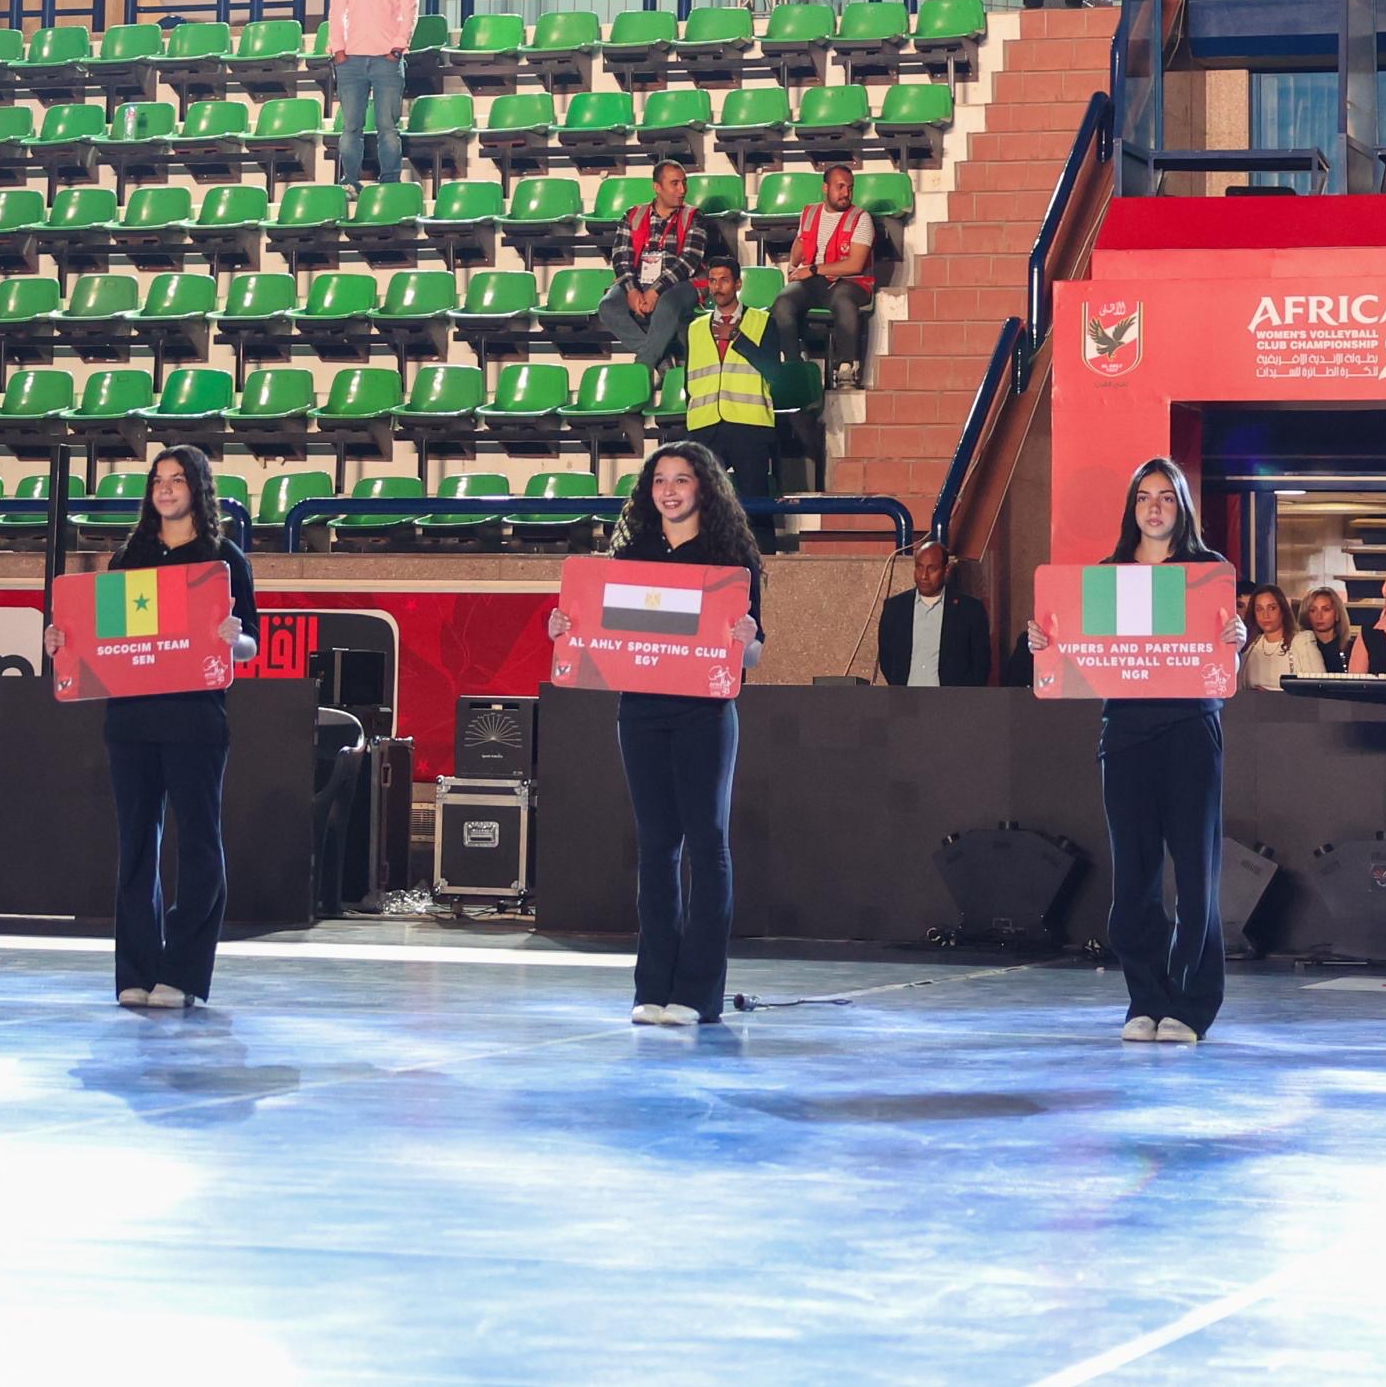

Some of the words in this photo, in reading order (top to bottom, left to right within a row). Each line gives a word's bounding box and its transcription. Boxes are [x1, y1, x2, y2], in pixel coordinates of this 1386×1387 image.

[1256, 330, 1307, 339] WOMEN'S
[1310, 330, 1379, 339] VOLLEYBALL
[1257, 341, 1287, 350] CLUB
[1290, 340, 1379, 350] CHAMPIONSHIP
[97, 642, 151, 656] SOCOCIM
[157, 639, 190, 650] TEAM
[569, 637, 585, 647] AL
[590, 639, 622, 650] AHLY
[628, 641, 689, 655] SPORTING
[695, 647, 727, 659] CLUB
[1058, 643, 1104, 654] VIPERS
[1110, 643, 1138, 653] AND
[1145, 643, 1213, 653] PARTNERS
[132, 655, 155, 665] SEN
[635, 655, 659, 666] EGY
[1077, 657, 1160, 667] VOLLEYBALL
[1166, 656, 1200, 666] CLUB
[1121, 669, 1149, 679] NGR
